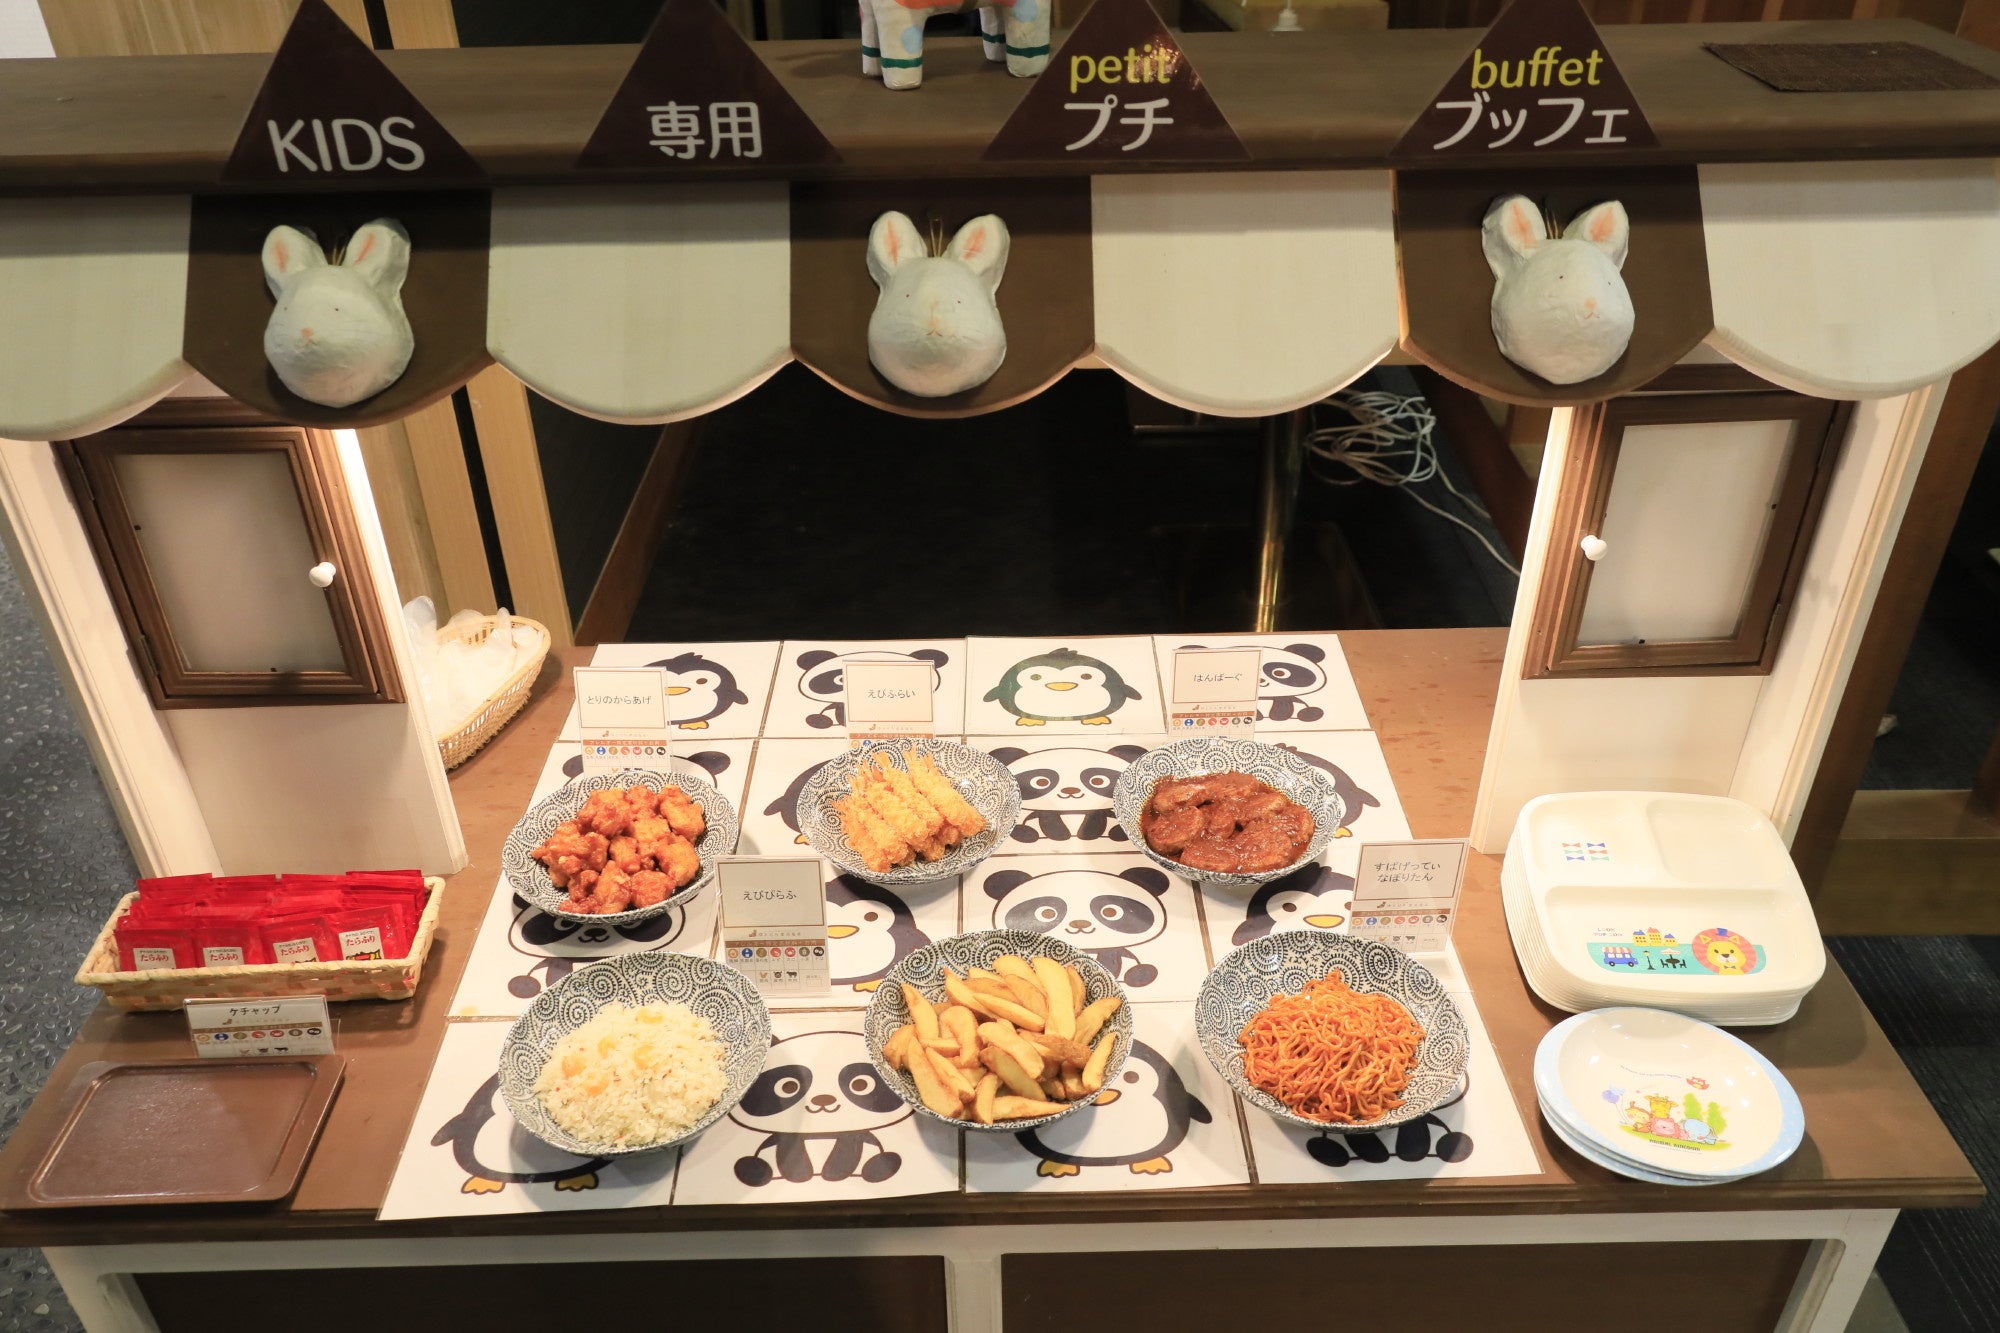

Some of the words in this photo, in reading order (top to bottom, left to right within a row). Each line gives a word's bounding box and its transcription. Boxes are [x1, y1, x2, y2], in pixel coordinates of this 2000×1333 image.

[1069, 44, 1171, 93] petit
[1470, 46, 1603, 90] buffet
[646, 101, 763, 160] 専用
[1063, 94, 1174, 151] プチ
[1433, 91, 1629, 149] ブッフェ
[267, 117, 425, 172] KIDS
[586, 695, 652, 705] とりのからあげ
[867, 688, 916, 699] えびふらい
[1194, 673, 1243, 683] はんばーぐ
[229, 1005, 281, 1017] ケチャップ
